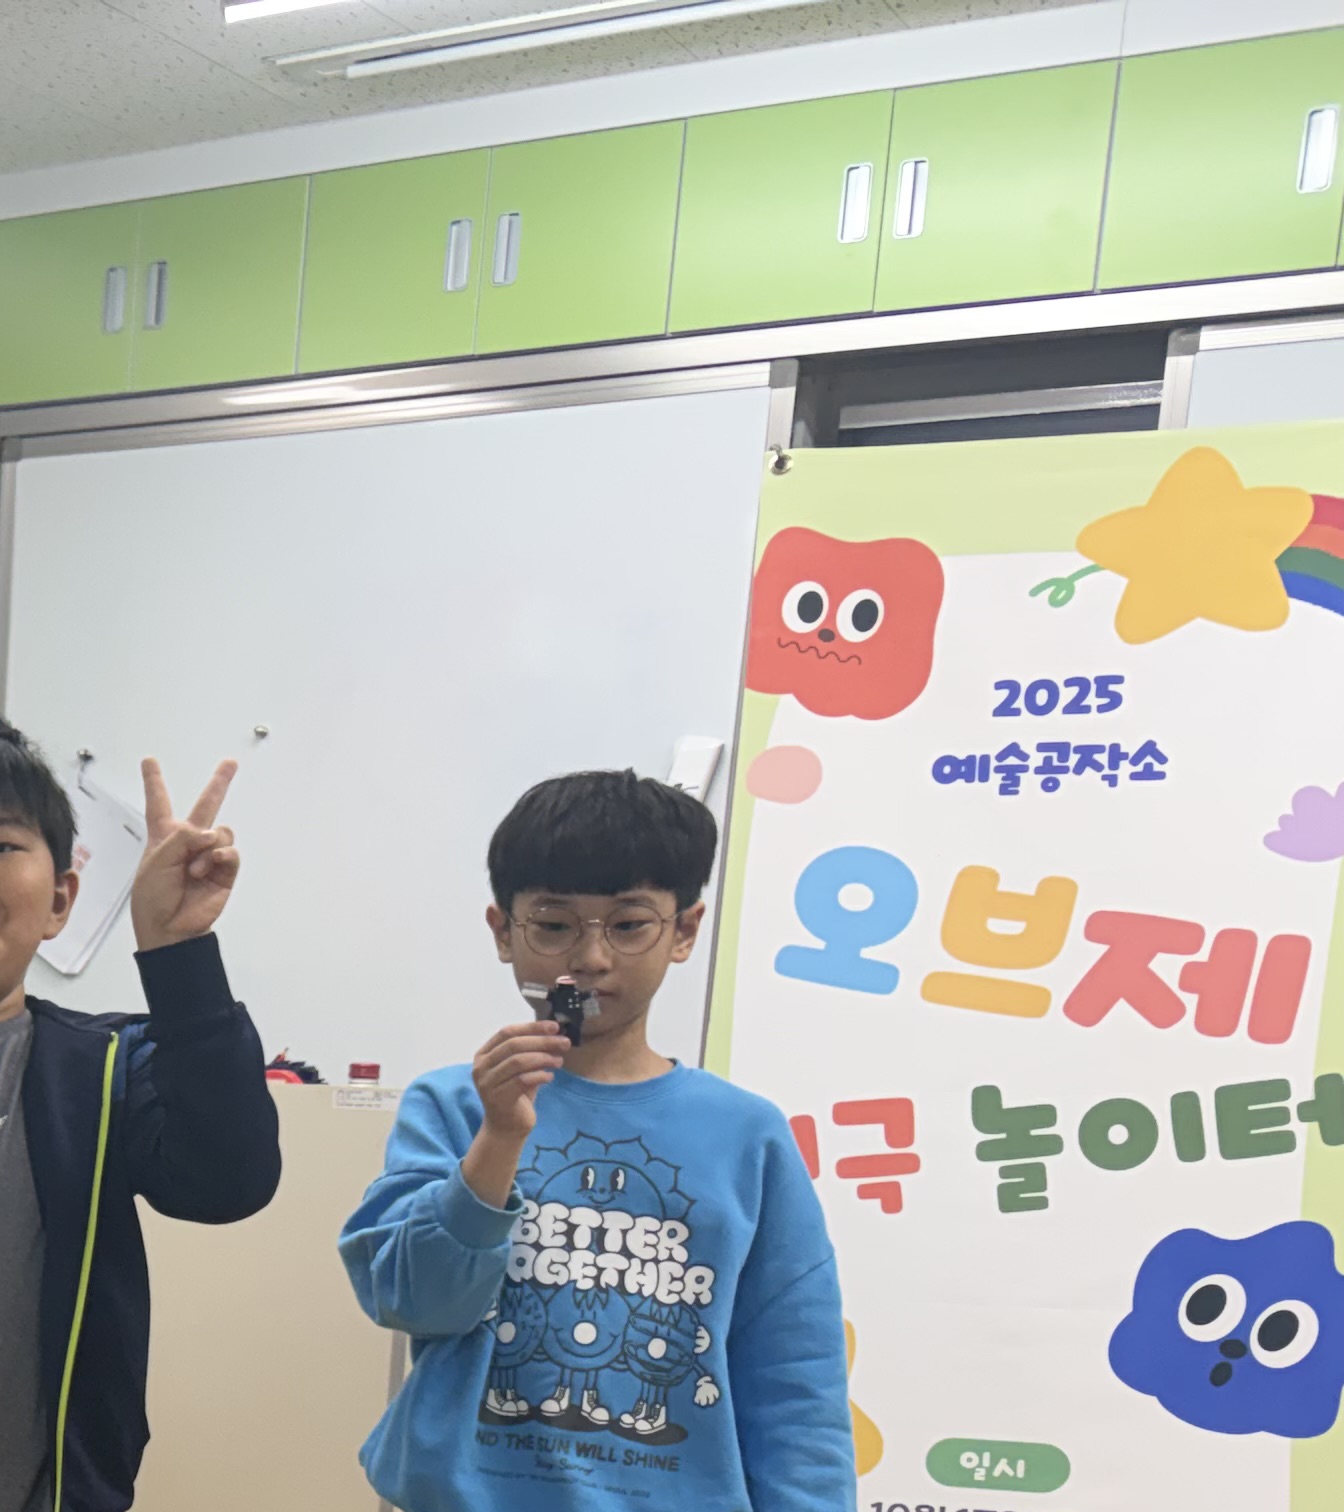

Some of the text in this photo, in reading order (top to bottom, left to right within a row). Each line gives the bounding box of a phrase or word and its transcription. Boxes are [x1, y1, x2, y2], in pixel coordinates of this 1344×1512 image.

[992, 675, 1125, 717] 2025
[931, 739, 1169, 796] 예술공작소
[773, 845, 1313, 1045] 오브제
[789, 1072, 1344, 1214] 극 놀이터
[511, 1198, 690, 1263] BETTER
[506, 1243, 716, 1305] OGETHER
[505, 1433, 534, 1450] THE
[536, 1435, 570, 1455] SUN
[575, 1440, 617, 1462] WILL
[622, 1448, 681, 1472] SHINE
[959, 1451, 1025, 1481] 일시
